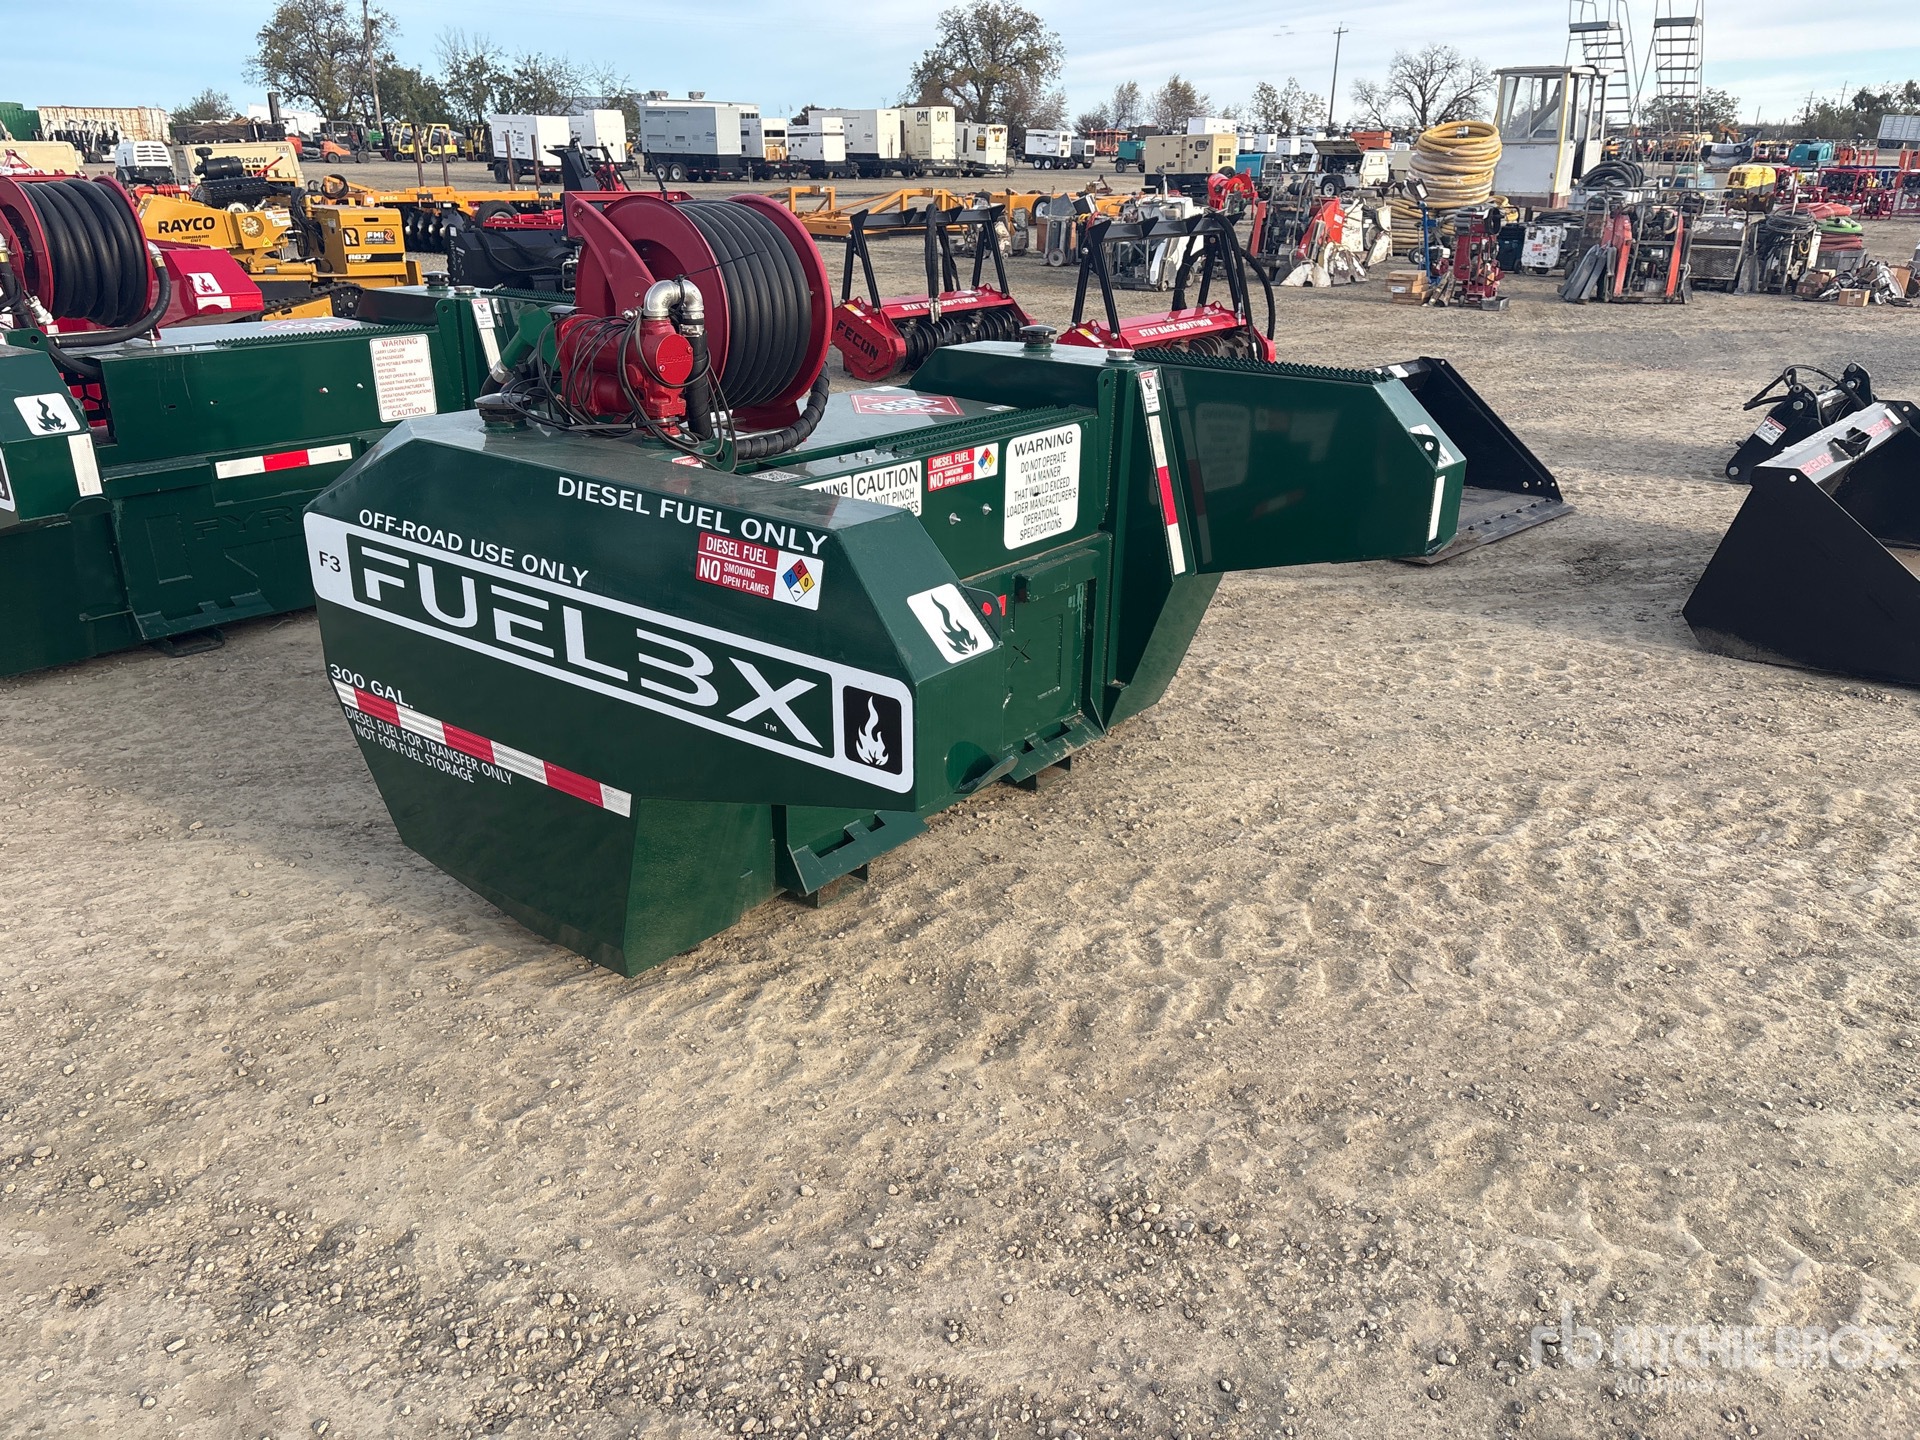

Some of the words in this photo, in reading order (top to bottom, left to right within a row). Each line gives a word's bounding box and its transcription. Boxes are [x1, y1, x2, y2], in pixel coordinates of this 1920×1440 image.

[916, 111, 928, 122] CAT
[937, 111, 948, 122] CAT
[158, 216, 216, 234] RAYCO
[1138, 327, 1158, 337] STAY
[1157, 324, 1178, 334] BACK
[1176, 322, 1190, 330] 300
[381, 338, 418, 348] WARNING
[836, 320, 879, 361] FECON
[392, 406, 426, 418] CAUTION
[1014, 431, 1072, 458] WARNING
[932, 456, 954, 469] DIESEL
[954, 452, 970, 464] FUEL
[1020, 462, 1030, 473] DO
[1030, 458, 1041, 470] NOT
[1042, 451, 1066, 468] OPERATE
[857, 465, 918, 496] CAUTION
[930, 472, 944, 489] NO
[944, 476, 956, 486] OPEN
[956, 472, 972, 482] FLAMES
[1026, 474, 1031, 485] IN
[1033, 472, 1036, 482] A
[1038, 466, 1061, 480] MANNER
[892, 488, 914, 504] PINCH
[1014, 488, 1028, 502] THAT
[1029, 482, 1049, 497] WOULD
[1050, 476, 1070, 492] EXCEED
[558, 477, 650, 515] DIESEL
[659, 498, 730, 534] FUEL
[741, 518, 828, 554] ONLY
[1006, 502, 1028, 518] LOADER
[1023, 506, 1060, 526] OPERATIONAL
[1020, 518, 1062, 540] SPECIFICATIONS
[359, 509, 463, 551] OFF-ROAD
[470, 539, 515, 568] USE
[521, 554, 589, 587] ONLY
[706, 537, 740, 558] DIESEL
[742, 546, 768, 564] FUEL
[318, 550, 341, 573] F3
[700, 558, 720, 580] NO
[724, 562, 756, 578] SMOKING
[798, 564, 802, 575] 2
[722, 574, 740, 588] OPEN
[742, 580, 770, 596] FLAMES
[788, 574, 793, 584] 1
[804, 578, 808, 588] 0
[330, 664, 366, 689] 300
[370, 680, 414, 709] GAL.
[345, 706, 376, 730] DIESEL
[377, 720, 400, 740] FUEL
[402, 730, 423, 750] FOR
[424, 738, 480, 773] TRANSFER
[482, 763, 512, 786] ONLY
[356, 724, 376, 742] NOT
[378, 734, 398, 752] FOR
[400, 743, 424, 764] FUEL
[425, 754, 474, 784] STORAGE
